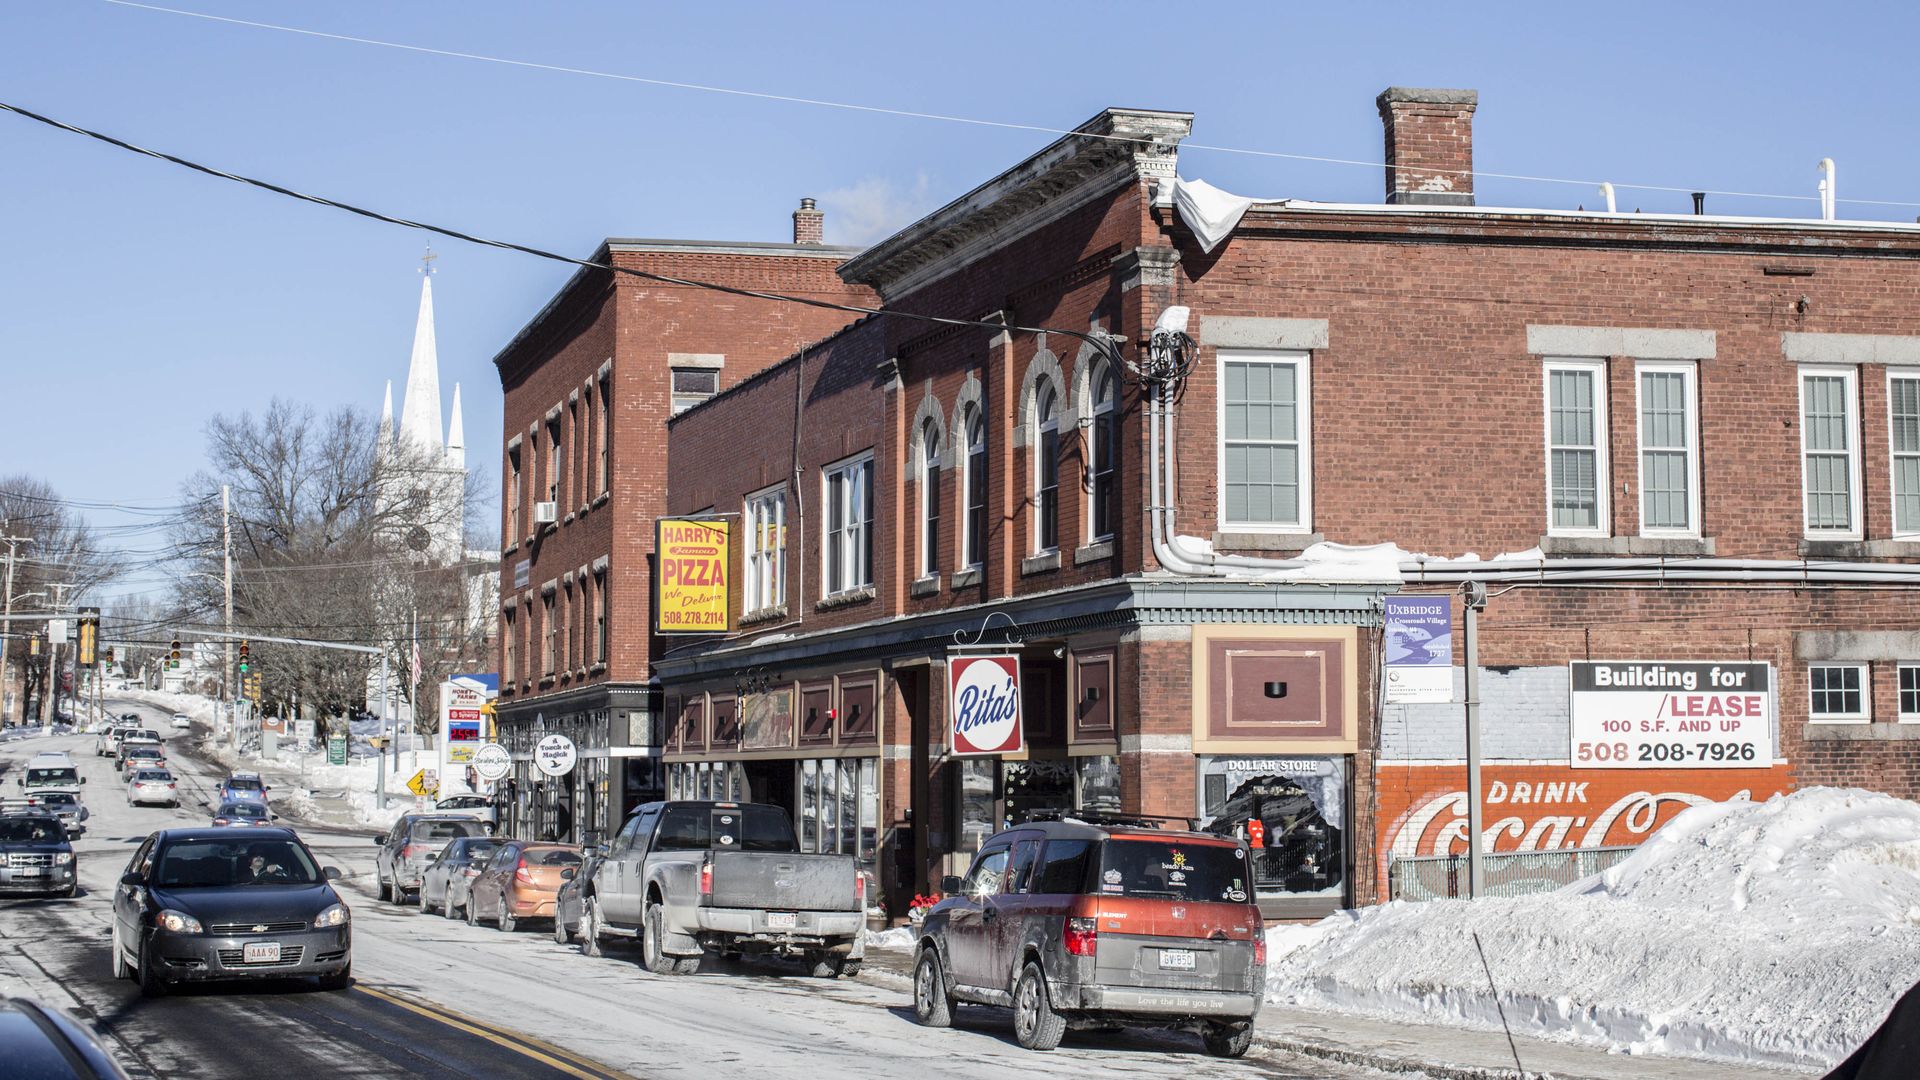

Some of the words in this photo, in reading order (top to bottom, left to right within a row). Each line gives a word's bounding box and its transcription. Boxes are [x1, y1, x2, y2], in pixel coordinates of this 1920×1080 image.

[663, 527, 725, 545] HARRY'S
[673, 546, 717, 555] Famous
[663, 558, 725, 587] PIZZA
[664, 588, 682, 600] We
[681, 593, 722, 607] Deliver
[664, 611, 724, 625] 508.278.2114
[1426, 617, 1447, 626] Village
[1595, 666, 1698, 690] Building
[1710, 666, 1746, 687] for
[956, 677, 1017, 733] Rita's
[458, 711, 479, 719] Synergy
[1601, 720, 1631, 732] 100
[1640, 720, 1670, 732] S.F.
[1678, 720, 1712, 732] AND
[1719, 720, 1741, 732] UP
[1577, 742, 1629, 761] 508
[1638, 742, 1755, 761] 208-7926
[1227, 760, 1276, 771] DOLLAR
[1280, 760, 1318, 772] STORE
[1486, 780, 1590, 804] DRINK
[1161, 862, 1179, 870] beach
[1138, 997, 1157, 1005] Love
[1160, 997, 1174, 1006] the
[1176, 998, 1189, 1007] life
[1192, 1001, 1207, 1009] you
[1209, 1000, 1223, 1008] live
